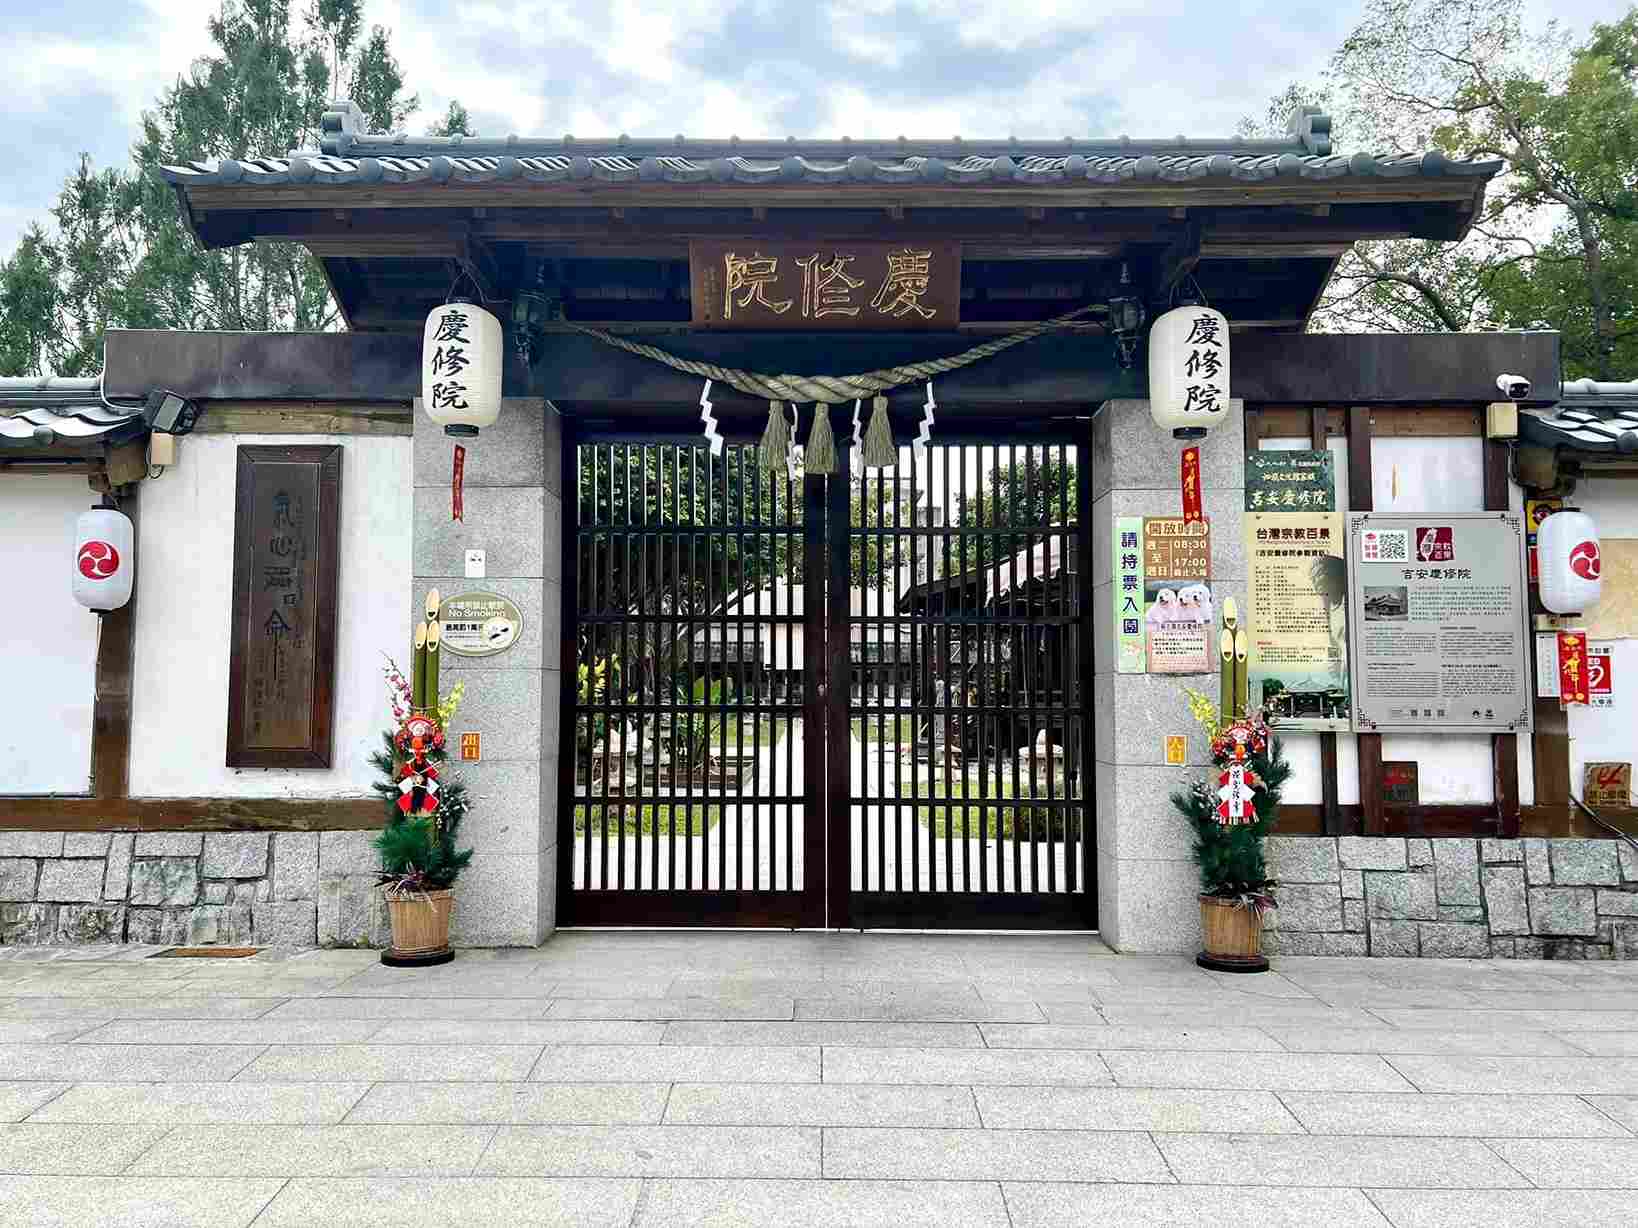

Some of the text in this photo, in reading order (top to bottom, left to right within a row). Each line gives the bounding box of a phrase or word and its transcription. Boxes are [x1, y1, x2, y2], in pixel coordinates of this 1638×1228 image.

[431, 309, 471, 410] 慶修院
[1183, 313, 1223, 413] 慶修院
[1256, 527, 1330, 540] 台灣宗教百景
[1174, 540, 1207, 548] 08:30
[1174, 558, 1207, 566] 17:00
[1401, 568, 1472, 580] 吉安慶修院
[1120, 532, 1138, 634] 請持票入園
[448, 607, 506, 617] No Smoking
